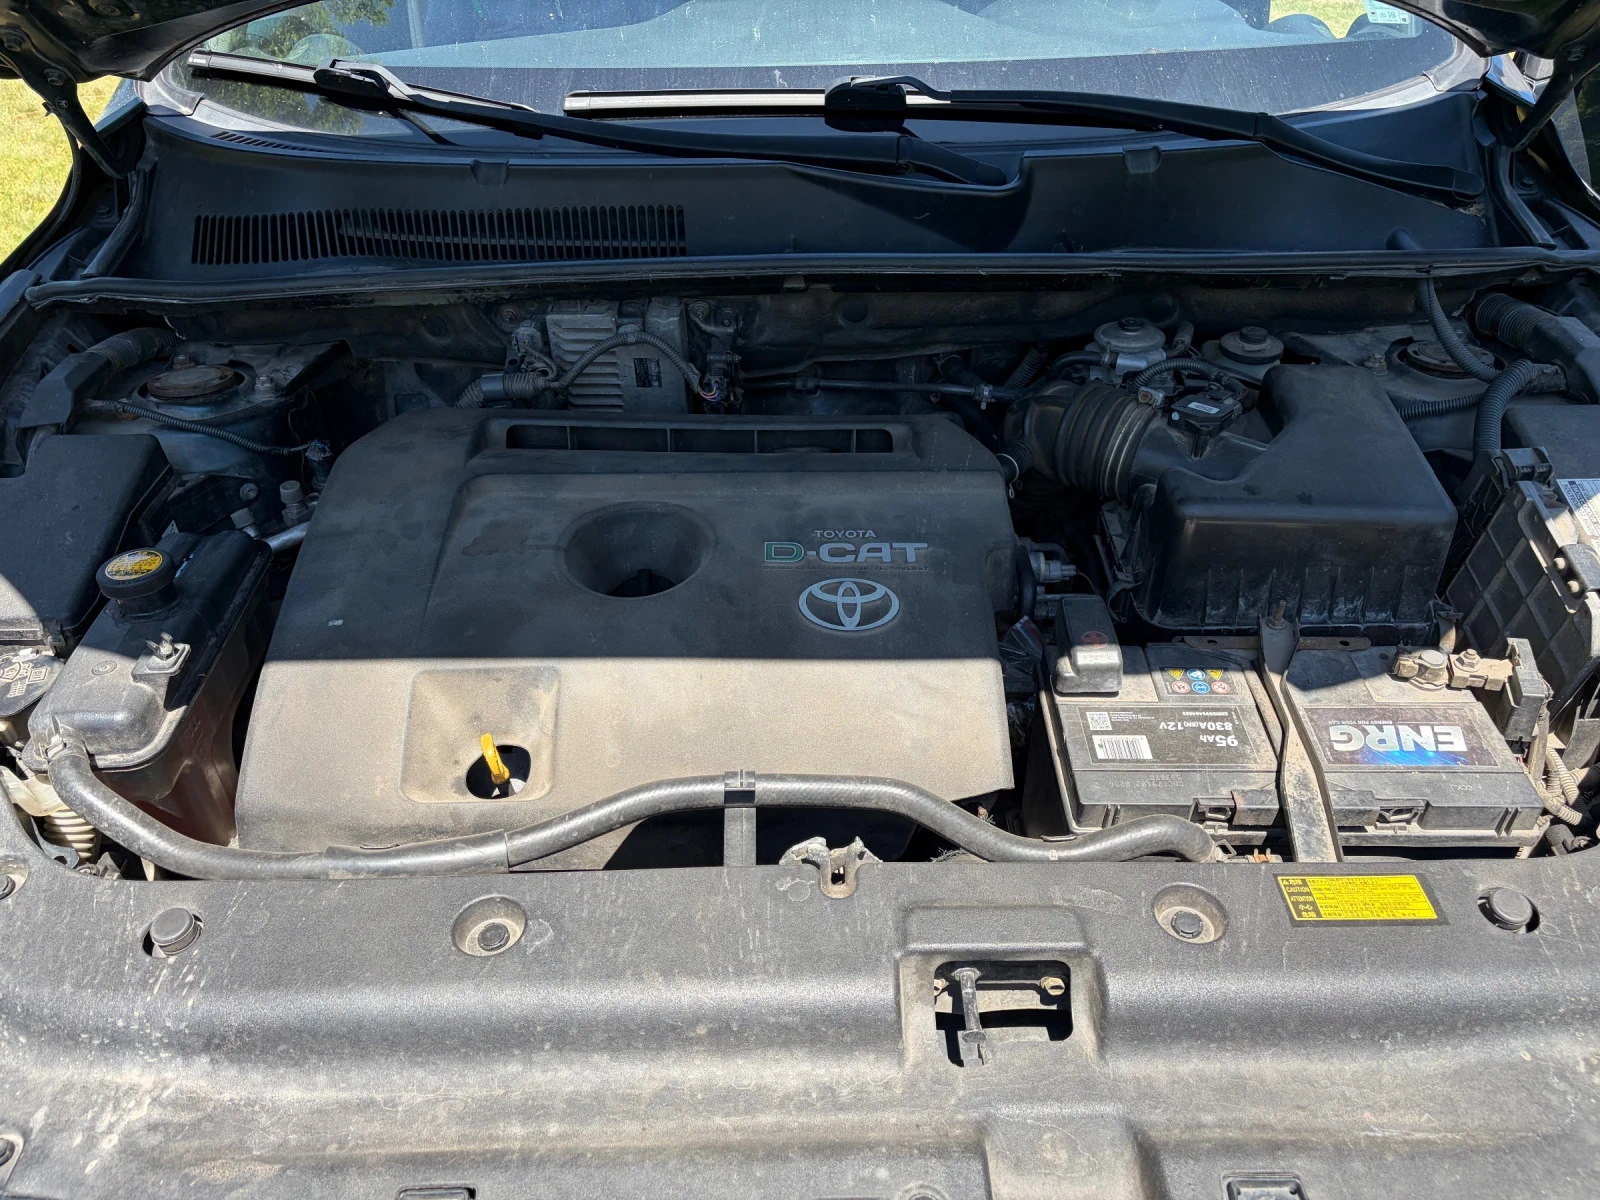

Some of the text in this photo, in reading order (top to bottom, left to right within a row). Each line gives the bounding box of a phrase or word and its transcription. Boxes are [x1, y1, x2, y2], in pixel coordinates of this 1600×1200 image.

[814, 530, 876, 539] TOYOTA
[764, 541, 928, 563] D-CAT
[1329, 725, 1467, 752] ENRG
